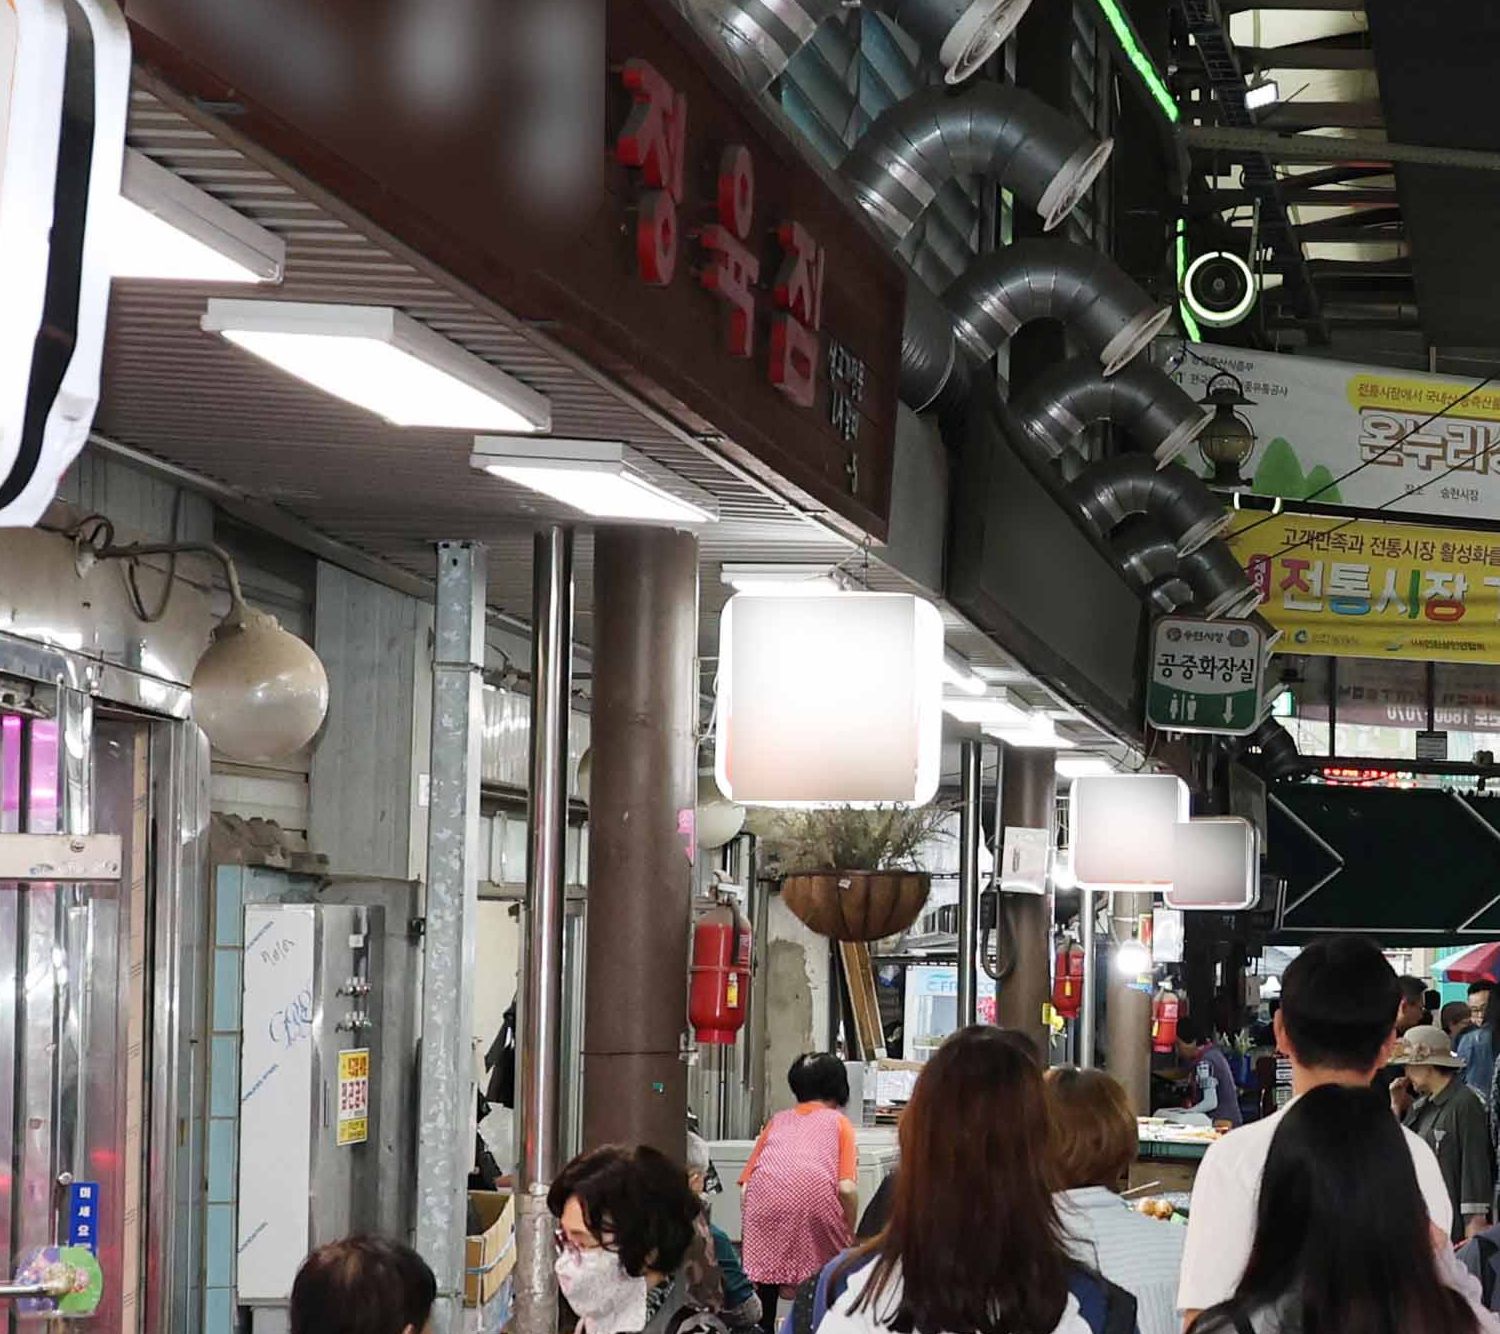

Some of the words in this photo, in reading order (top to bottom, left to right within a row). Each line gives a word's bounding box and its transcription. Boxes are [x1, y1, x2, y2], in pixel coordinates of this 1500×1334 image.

[617, 58, 826, 409] 정육점
[1281, 527, 1364, 555] 고객만족과
[1369, 534, 1437, 562] 전통시장
[1280, 558, 1470, 622] 전통시장
[1158, 653, 1255, 684] 공중화장실
[76, 1186, 92, 1237] 미세요
